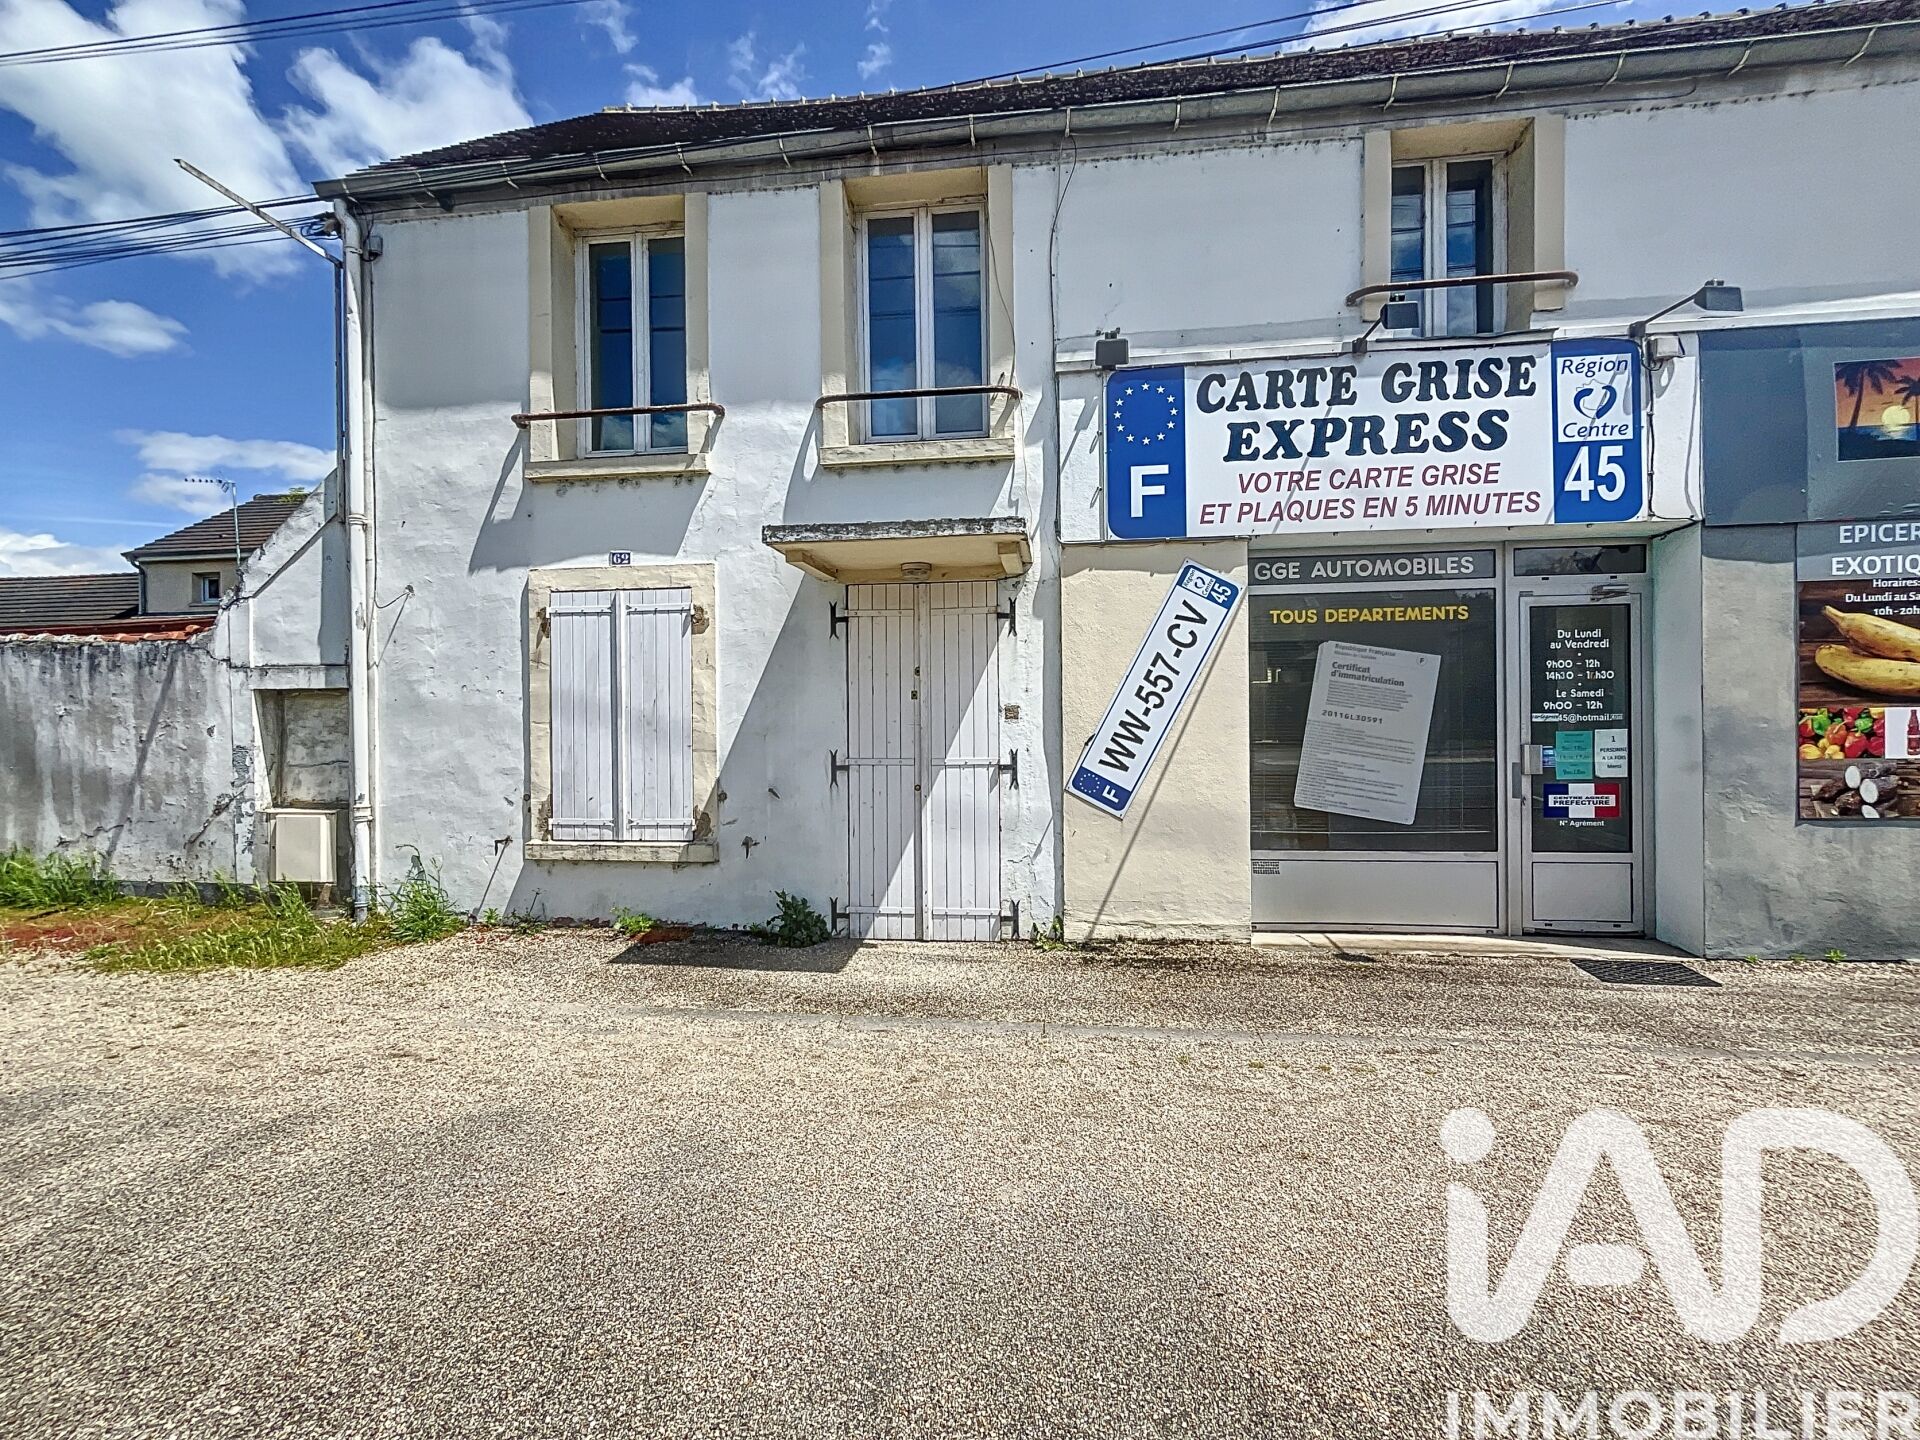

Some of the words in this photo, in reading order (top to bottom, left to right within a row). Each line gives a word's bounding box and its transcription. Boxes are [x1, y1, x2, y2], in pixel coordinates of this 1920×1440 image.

[1561, 358, 1629, 378] Région
[1196, 365, 1357, 413] CARTE
[1381, 355, 1537, 403] GRISE
[1223, 409, 1510, 462] EXPRESS
[1563, 422, 1630, 438] Centre
[1238, 469, 1322, 494] VOTRE
[1329, 465, 1414, 490] CARTE
[1421, 462, 1501, 487] GRISE
[1564, 445, 1626, 502] 45
[1130, 464, 1169, 518] F
[1200, 503, 1232, 524] ET
[1237, 498, 1355, 523] PLAQUES
[1363, 496, 1398, 518] EN
[1405, 495, 1418, 517] 5
[1426, 491, 1541, 516] MINUTES
[1840, 523, 1920, 543] EPICER
[613, 553, 629, 564] 62
[1832, 554, 1920, 576] EXOTIQ
[1254, 562, 1300, 580] GGE
[1310, 557, 1474, 578] AUTOMOBILES
[1210, 583, 1231, 603] 45
[1845, 593, 1860, 602] Du
[1863, 592, 1892, 601] Lundi
[1270, 609, 1317, 624] TOUS
[1325, 605, 1469, 623] DEPARTEMENTS
[1874, 606, 1893, 615] 10h
[1900, 605, 1920, 614] 20h
[1557, 629, 1571, 638] Du
[1574, 629, 1602, 638] Lundi
[1565, 639, 1609, 648] Vendredi
[1332, 661, 1371, 674] Certificat
[1546, 660, 1573, 668] 9h00
[1585, 659, 1600, 668] 12h
[1330, 669, 1405, 687] d'immatriculation
[1545, 671, 1574, 680] 14h30
[1098, 599, 1208, 772] WW-557-CV
[1556, 689, 1567, 698] Le
[1570, 688, 1604, 697] Samedi
[1543, 701, 1572, 710] 9h00
[1586, 701, 1603, 709] 12h
[1102, 785, 1119, 803] F
